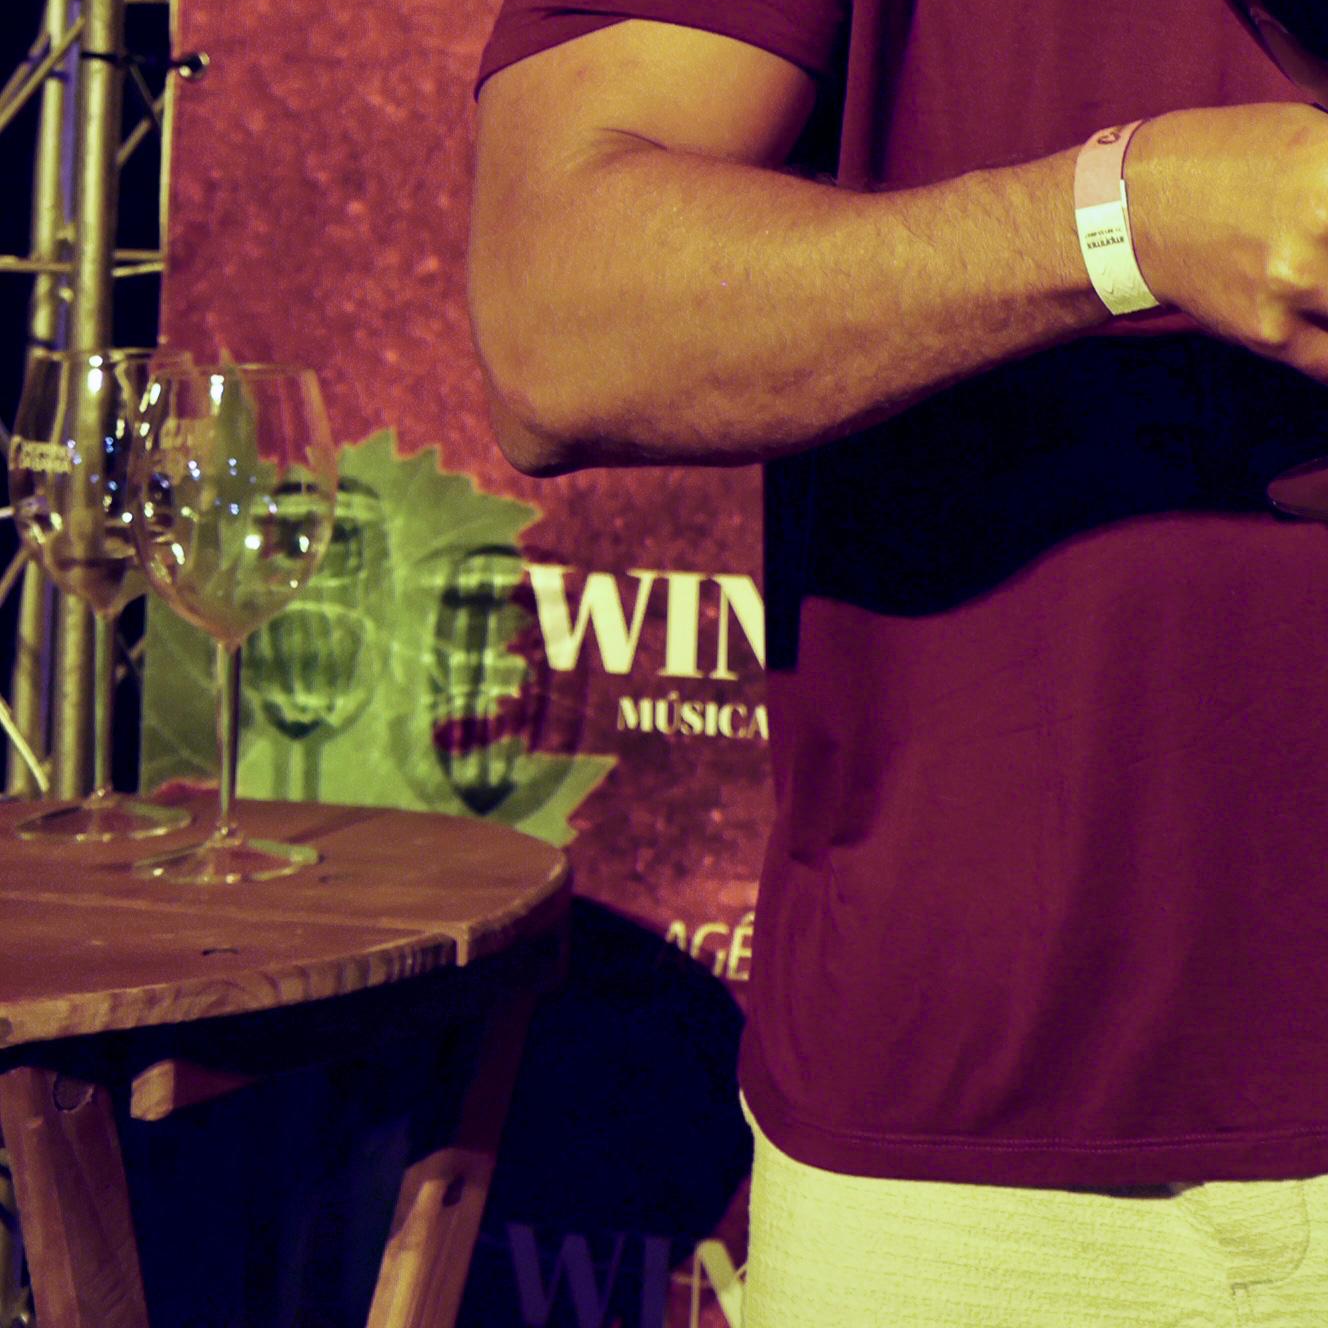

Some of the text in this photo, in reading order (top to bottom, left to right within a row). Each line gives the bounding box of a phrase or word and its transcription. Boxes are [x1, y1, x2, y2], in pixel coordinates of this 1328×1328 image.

[524, 564, 766, 682] WIN
[616, 689, 769, 741] MÚSICA
[500, 1221, 749, 1328] WIN
